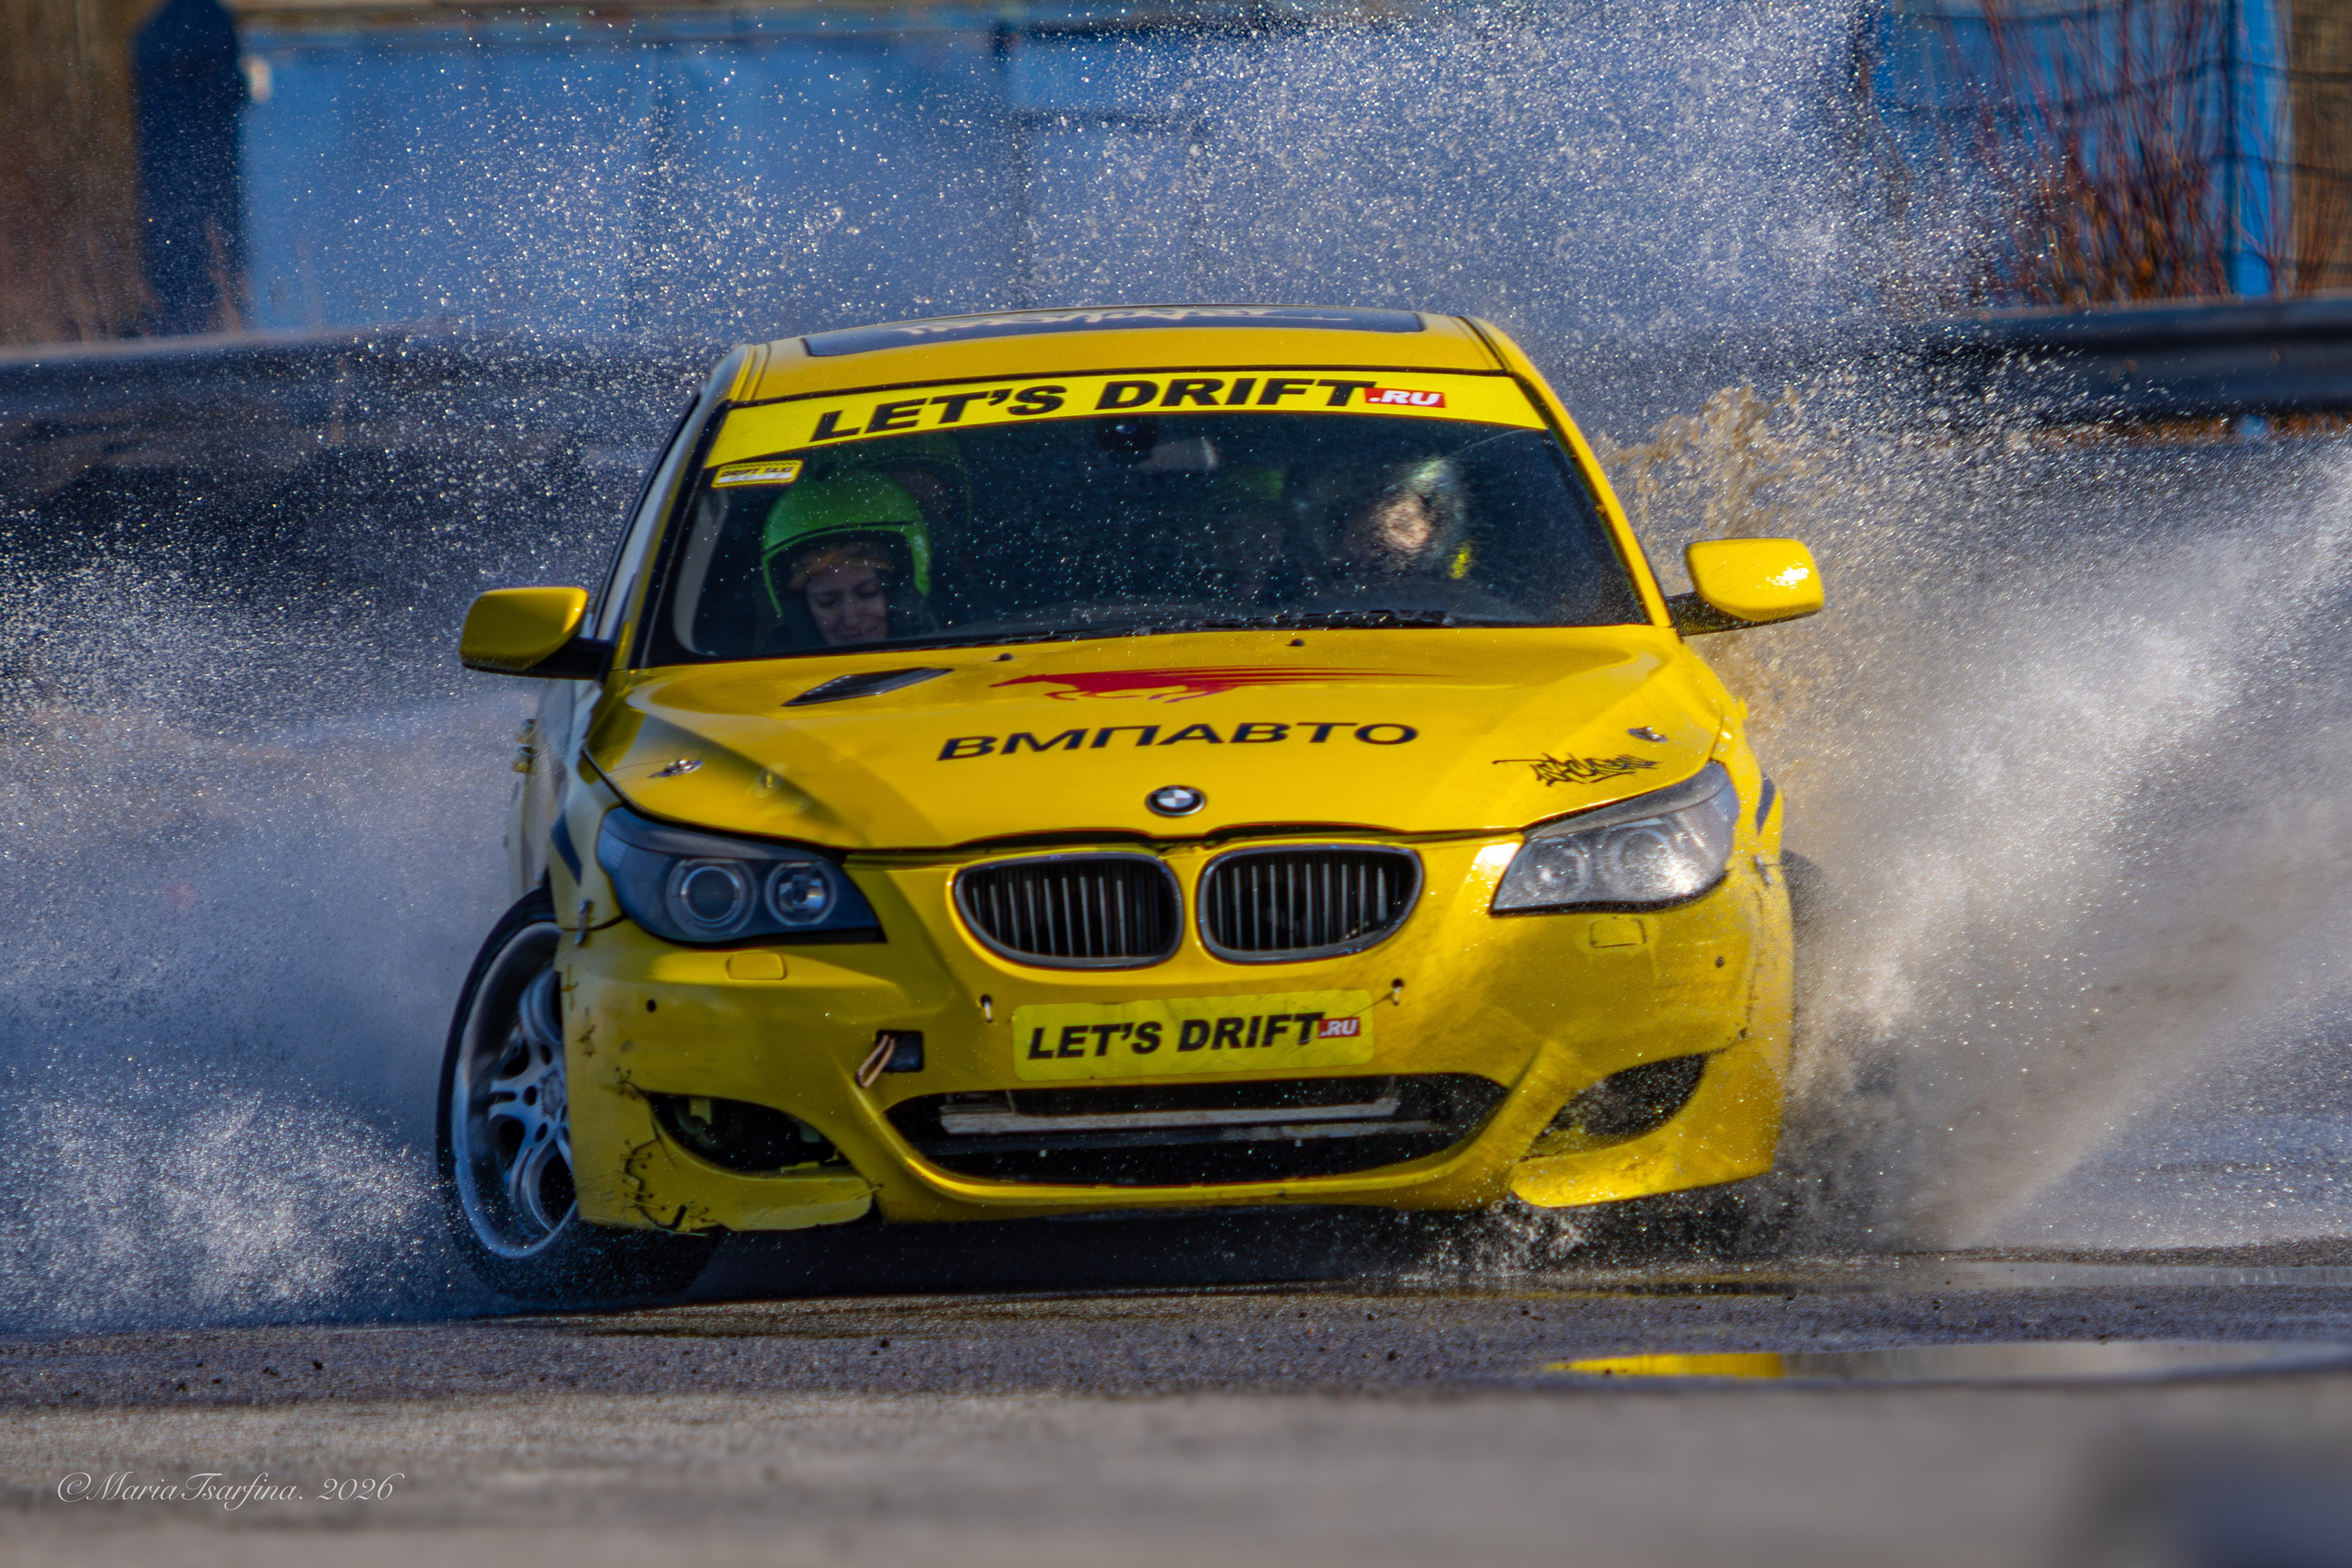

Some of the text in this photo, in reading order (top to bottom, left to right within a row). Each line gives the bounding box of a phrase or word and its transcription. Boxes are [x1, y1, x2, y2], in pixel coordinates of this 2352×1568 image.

[808, 384, 1068, 443] LET’S
[937, 722, 1419, 761] ВМПАВТО
[1026, 1021, 1163, 1061] LET’S
